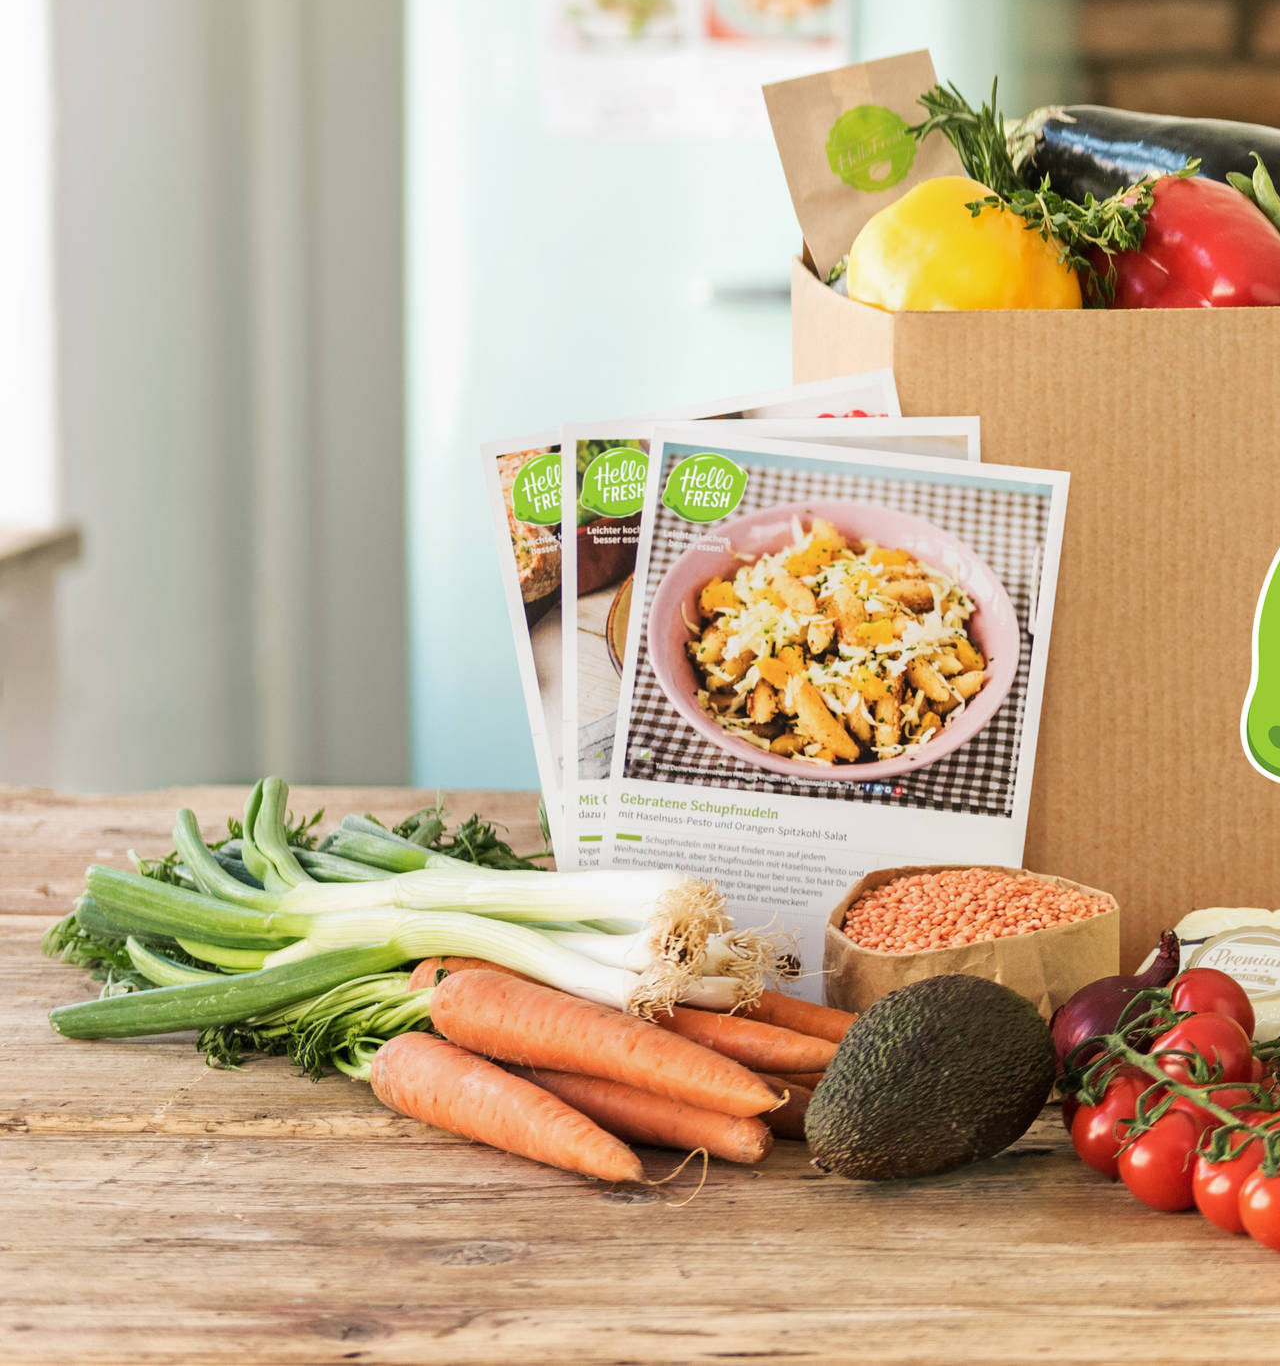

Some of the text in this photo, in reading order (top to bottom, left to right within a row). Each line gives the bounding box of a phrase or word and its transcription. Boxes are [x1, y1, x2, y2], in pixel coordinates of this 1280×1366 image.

[593, 459, 646, 491] Hello
[679, 465, 734, 494] Hello
[602, 482, 646, 504] FRESH
[683, 490, 731, 509] FRESH
[586, 525, 622, 535] Leichter
[593, 535, 621, 545] besser
[578, 794, 599, 806] Mit
[619, 792, 688, 811] Gebratene
[690, 798, 779, 821] Schupfnudeln
[578, 809, 601, 819] dazu
[618, 809, 634, 820] mit
[635, 810, 713, 829] Haselnuss-Pesto
[714, 819, 733, 831] und
[734, 820, 848, 843] Orangen-Spitzkohl-Salat
[645, 834, 826, 863] Schupfnudeln mit Kraut findet man auf jedem
[578, 858, 599, 867] Es ist
[611, 855, 631, 865] dem
[631, 857, 674, 871] fruchtigen
[714, 865, 743, 877] findest
[743, 868, 756, 878] Du
[757, 872, 771, 880] nur
[771, 871, 785, 881] bei
[805, 875, 816, 885] So
[816, 876, 835, 887] hast
[836, 879, 848, 888] Du
[613, 843, 865, 878] Weihnachtsmarkt, aber Schupfnudeln mit Haselnuss-Pesto und
[700, 876, 823, 898] fruhtige Orangen und leckeres
[736, 894, 746, 902] es
[746, 893, 759, 903] Dir
[760, 895, 809, 908] schmecken!
